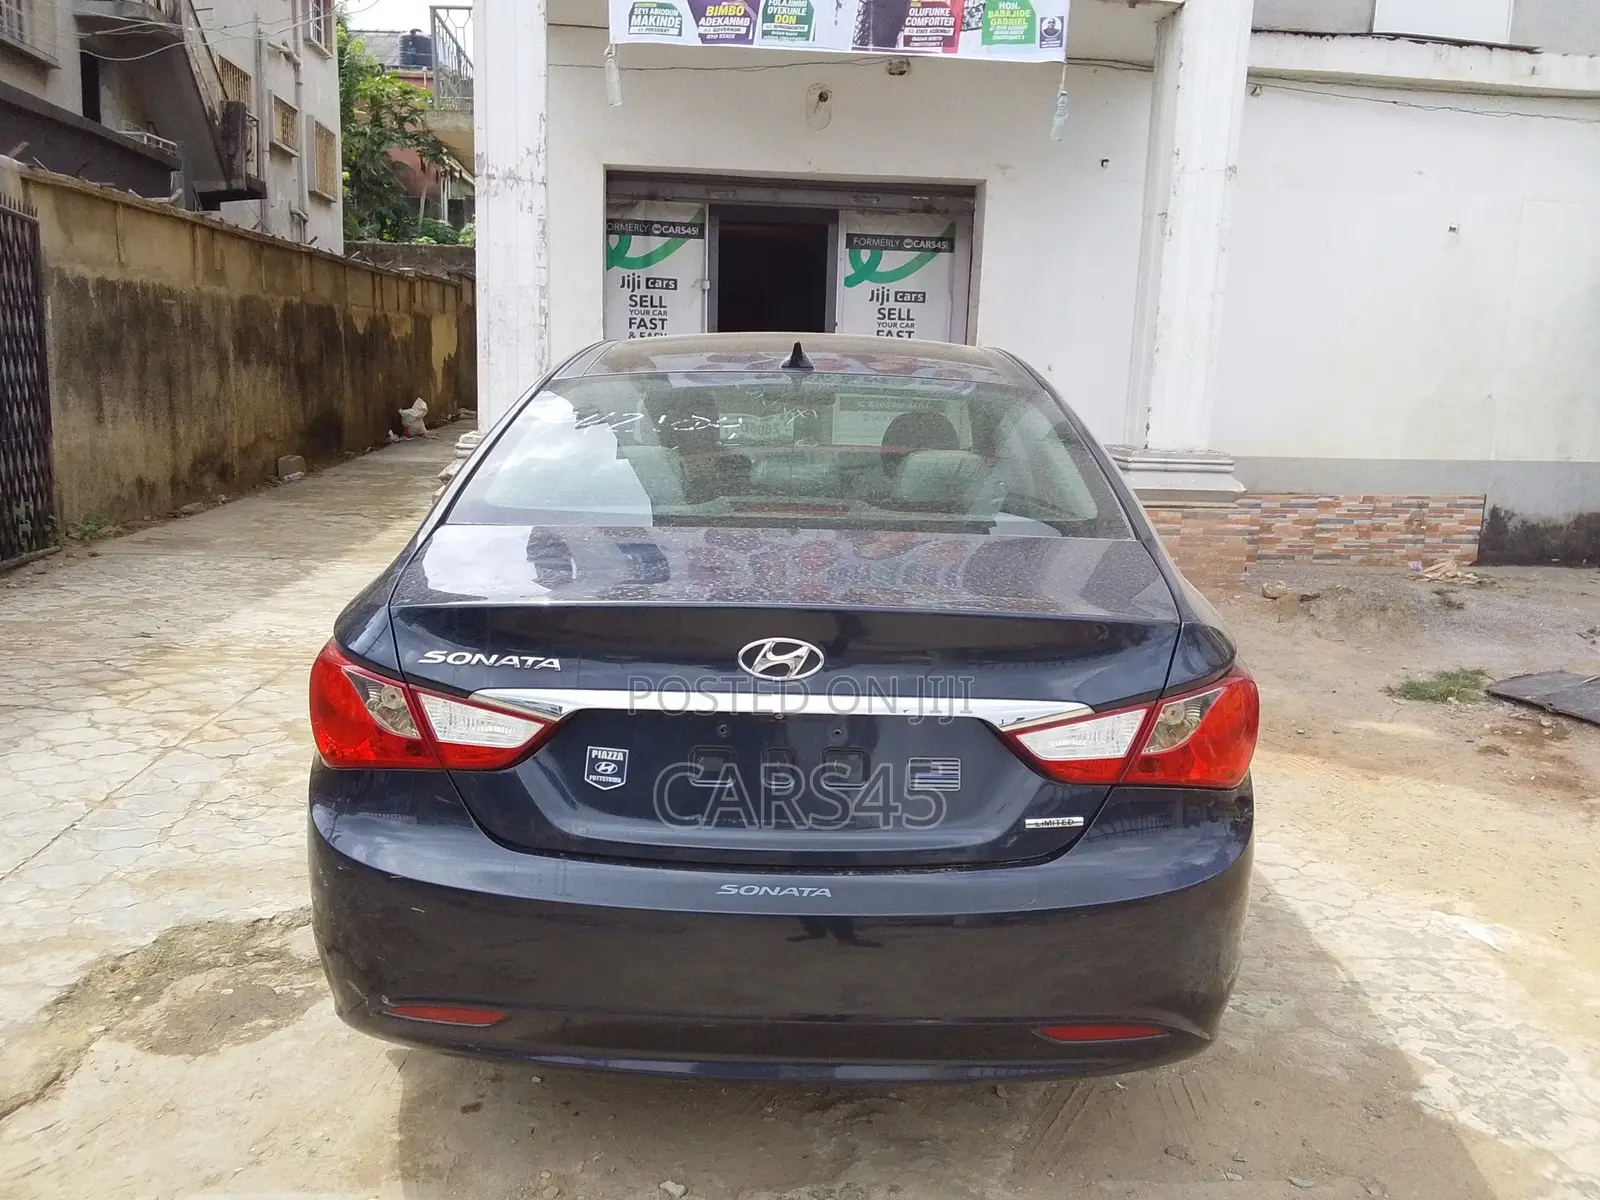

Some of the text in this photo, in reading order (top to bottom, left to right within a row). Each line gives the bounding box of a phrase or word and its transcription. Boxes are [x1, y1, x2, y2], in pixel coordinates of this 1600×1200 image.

[706, 5, 745, 16] BIMBO
[909, 7, 951, 16] OLUFUNKE
[631, 15, 682, 28] MAKINDE
[774, 14, 797, 24] DON
[905, 16, 955, 26] COMFORTER
[606, 222, 649, 233] ORMERLY
[853, 237, 900, 247] FORMERLY
[620, 272, 676, 292] Jiji cars
[629, 294, 667, 308] SELL
[869, 286, 924, 306] Jiji cars
[877, 307, 915, 321] SELL
[629, 317, 668, 330] FAST
[418, 650, 561, 671] SONATA
[592, 750, 624, 761] PIAZZA
[716, 884, 832, 898] SONATA
